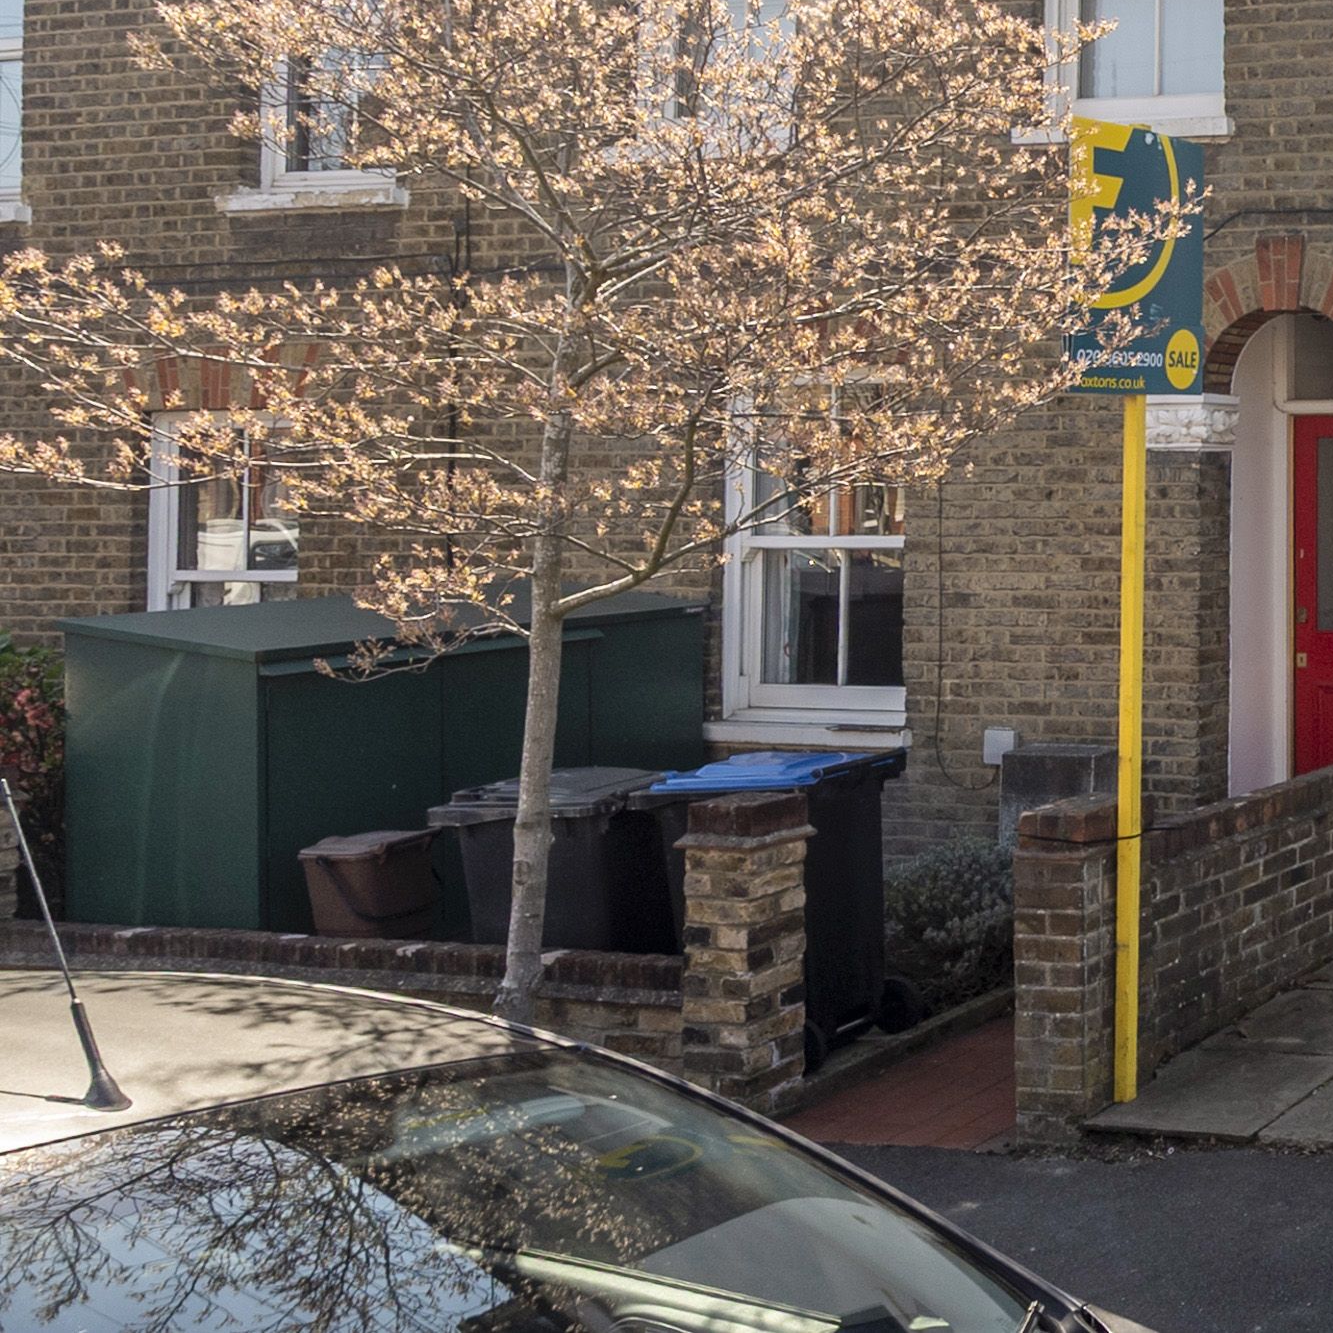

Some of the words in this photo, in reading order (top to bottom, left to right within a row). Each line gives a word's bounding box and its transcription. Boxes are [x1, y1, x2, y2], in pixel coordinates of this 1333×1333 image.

[1104, 350, 1135, 366] 605
[1168, 350, 1197, 368] SALE
[1077, 375, 1146, 389] oxtons.co.uk
